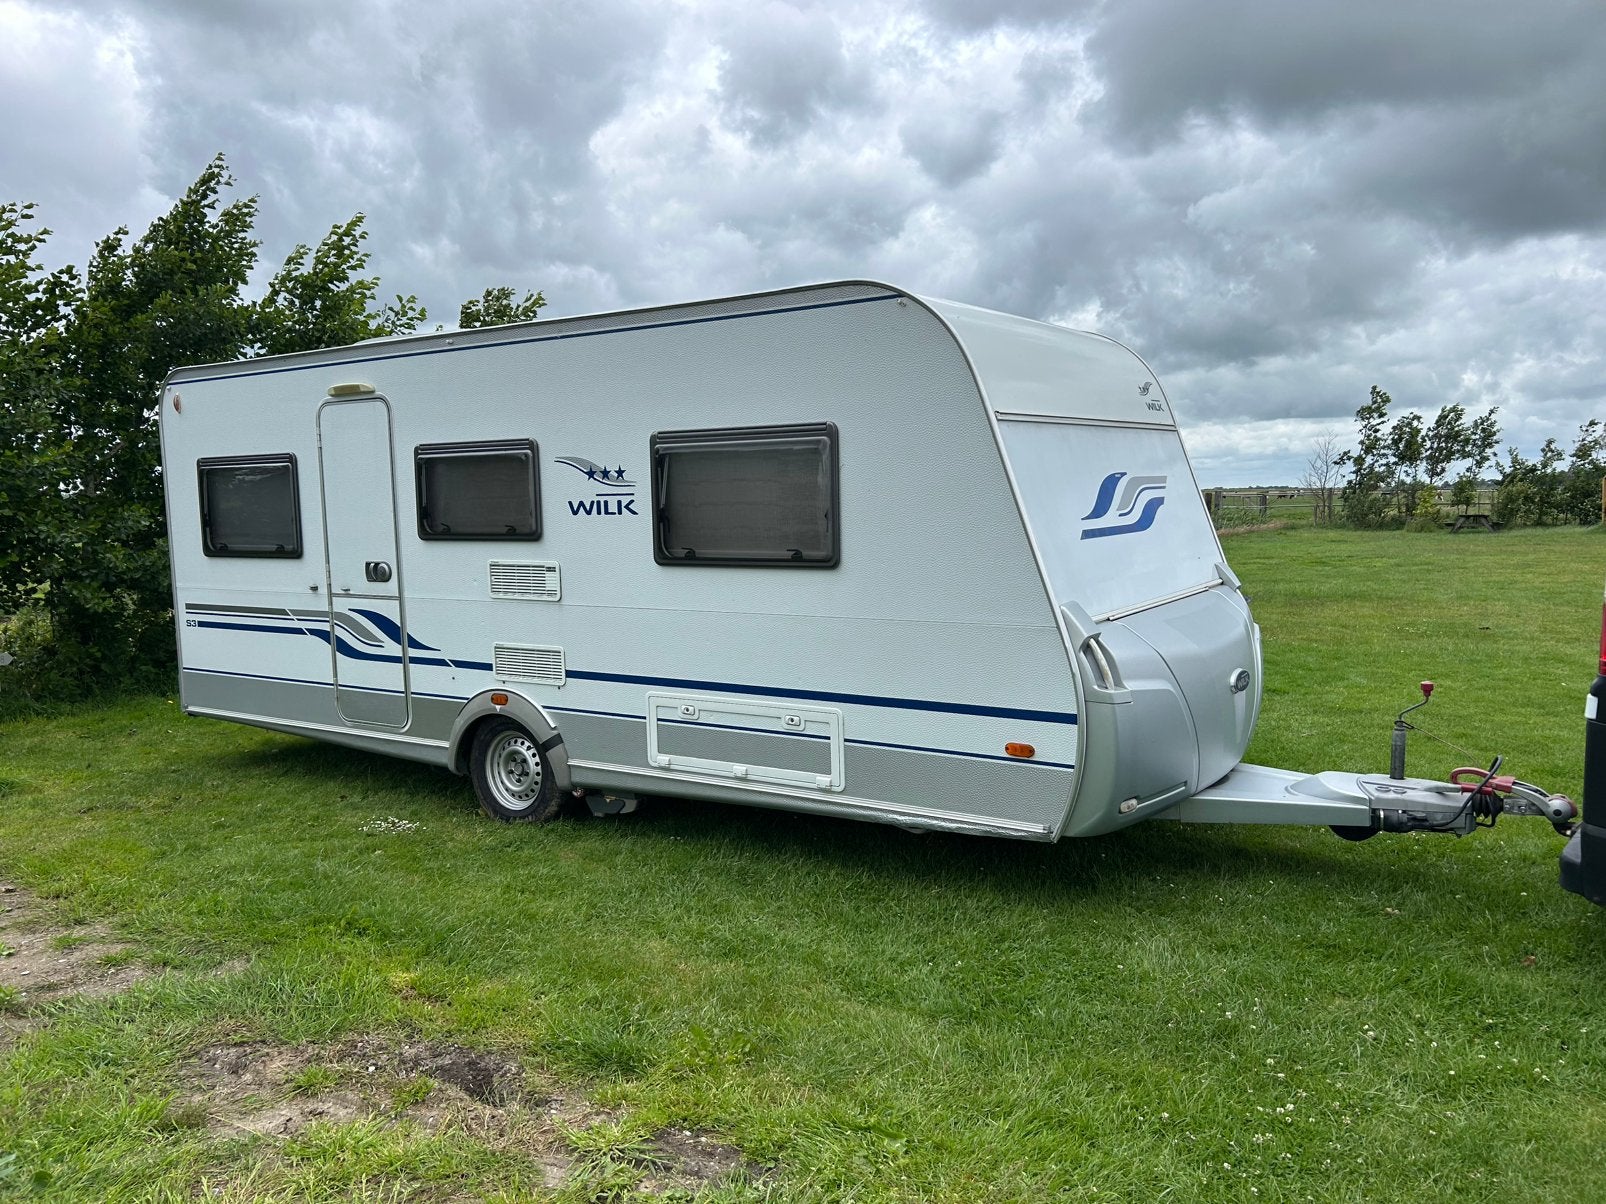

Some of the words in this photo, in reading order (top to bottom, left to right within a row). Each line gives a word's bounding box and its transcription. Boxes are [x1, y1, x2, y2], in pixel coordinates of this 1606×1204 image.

[1145, 402, 1165, 412] WILK
[567, 499, 639, 516] WILK
[185, 619, 197, 627] S3
